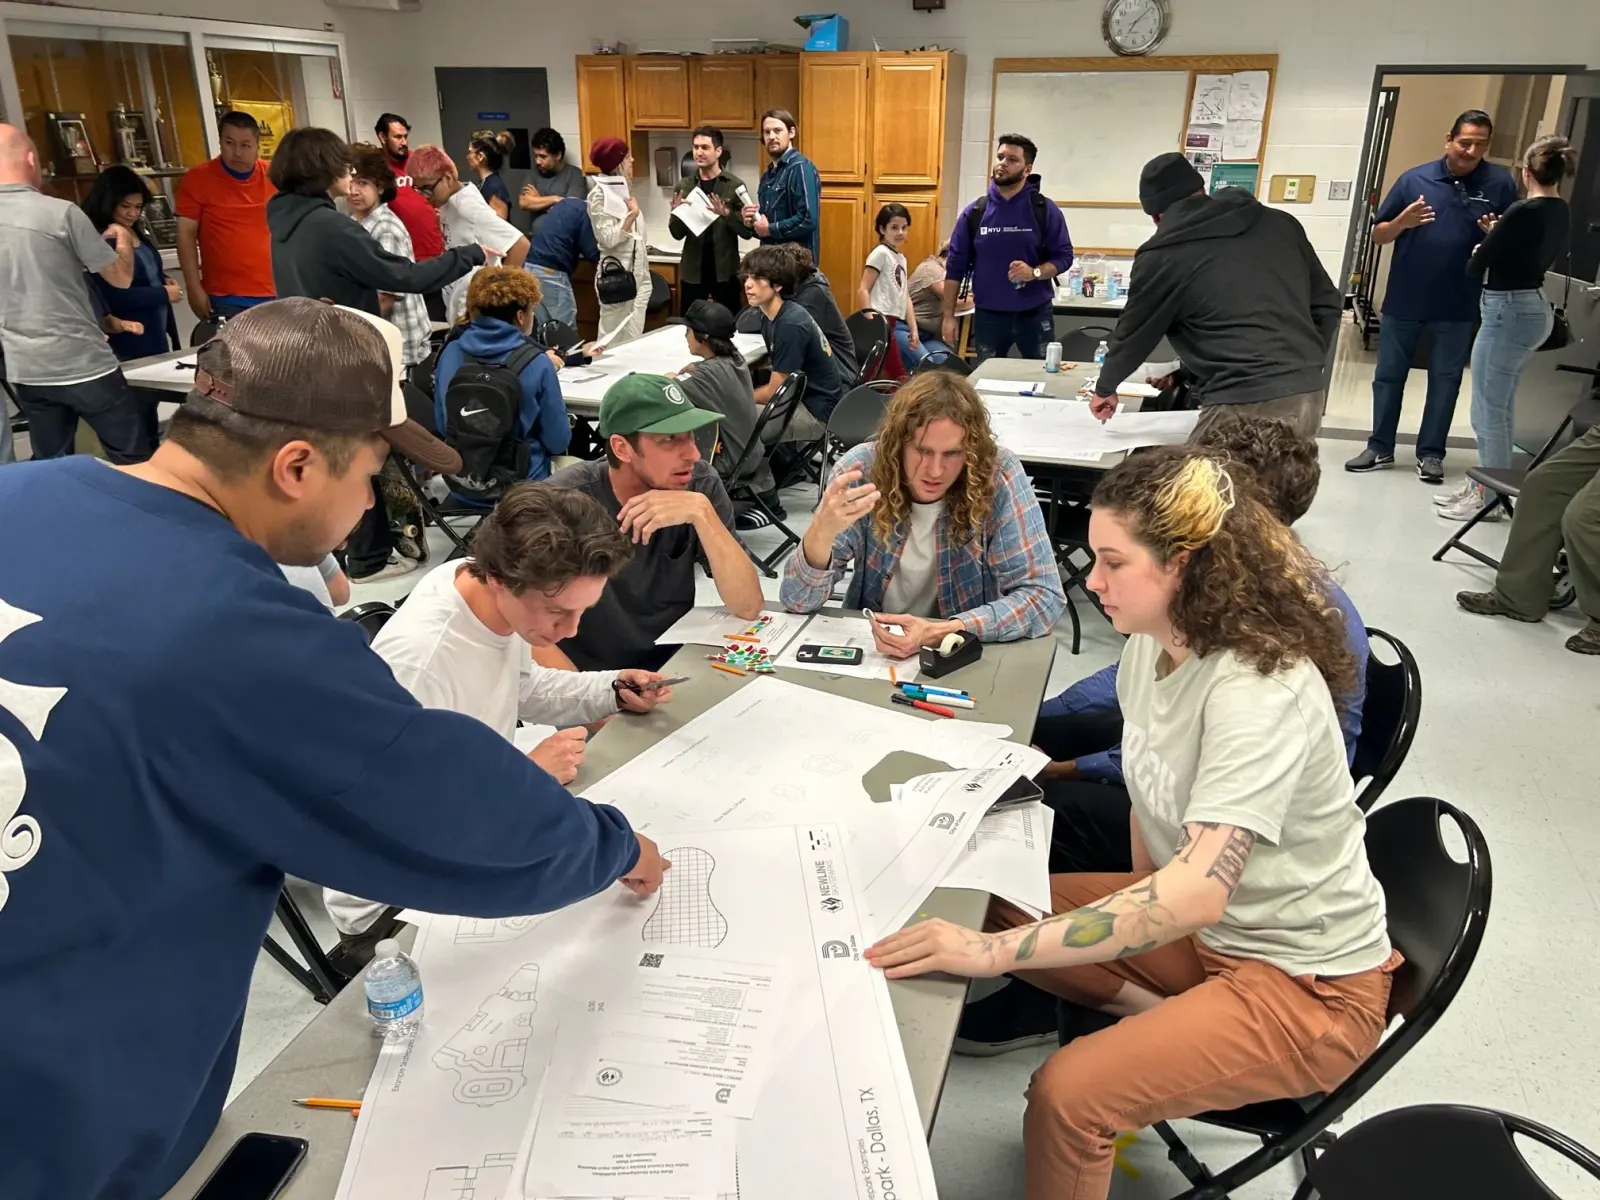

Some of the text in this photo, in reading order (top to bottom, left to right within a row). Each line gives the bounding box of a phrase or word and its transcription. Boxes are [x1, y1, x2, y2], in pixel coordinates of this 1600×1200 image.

[815, 860, 832, 897] NEWLINE
[391, 1067, 407, 1092] Example
[858, 1087, 875, 1104] TX
[866, 1105, 886, 1154] Dallas,
[857, 1138, 870, 1174] Examples
